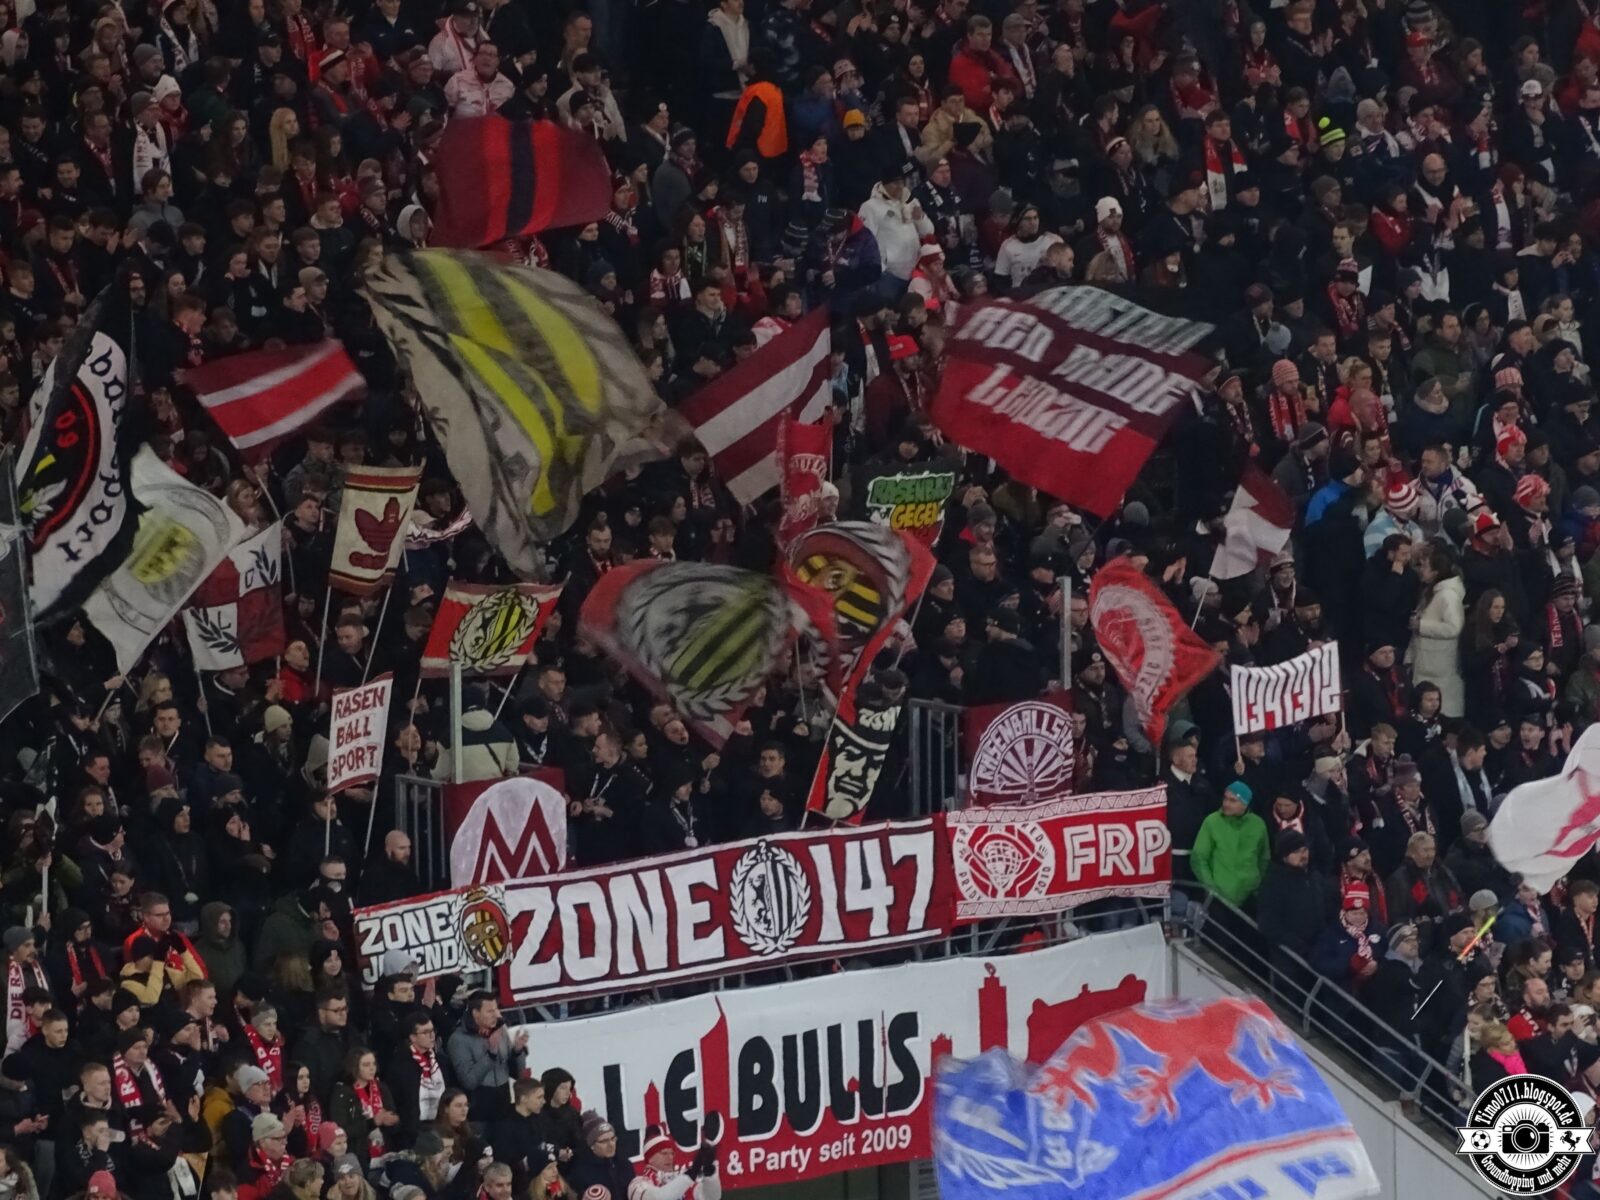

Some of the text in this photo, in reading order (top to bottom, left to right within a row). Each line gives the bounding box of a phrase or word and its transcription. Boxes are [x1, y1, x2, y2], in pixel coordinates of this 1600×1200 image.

[335, 686, 385, 721] RASEN
[336, 717, 371, 749] BALL
[331, 745, 377, 780] SPORT
[1063, 820, 1171, 882] FRP
[359, 902, 455, 955] ZONE
[504, 831, 934, 990] ZONE 147
[362, 940, 459, 984] JEND
[738, 1012, 920, 1136] BULLS
[727, 1151, 744, 1176] &
[750, 1145, 812, 1173] Party
[819, 1133, 855, 1162] seit
[861, 1124, 912, 1154] 2009
